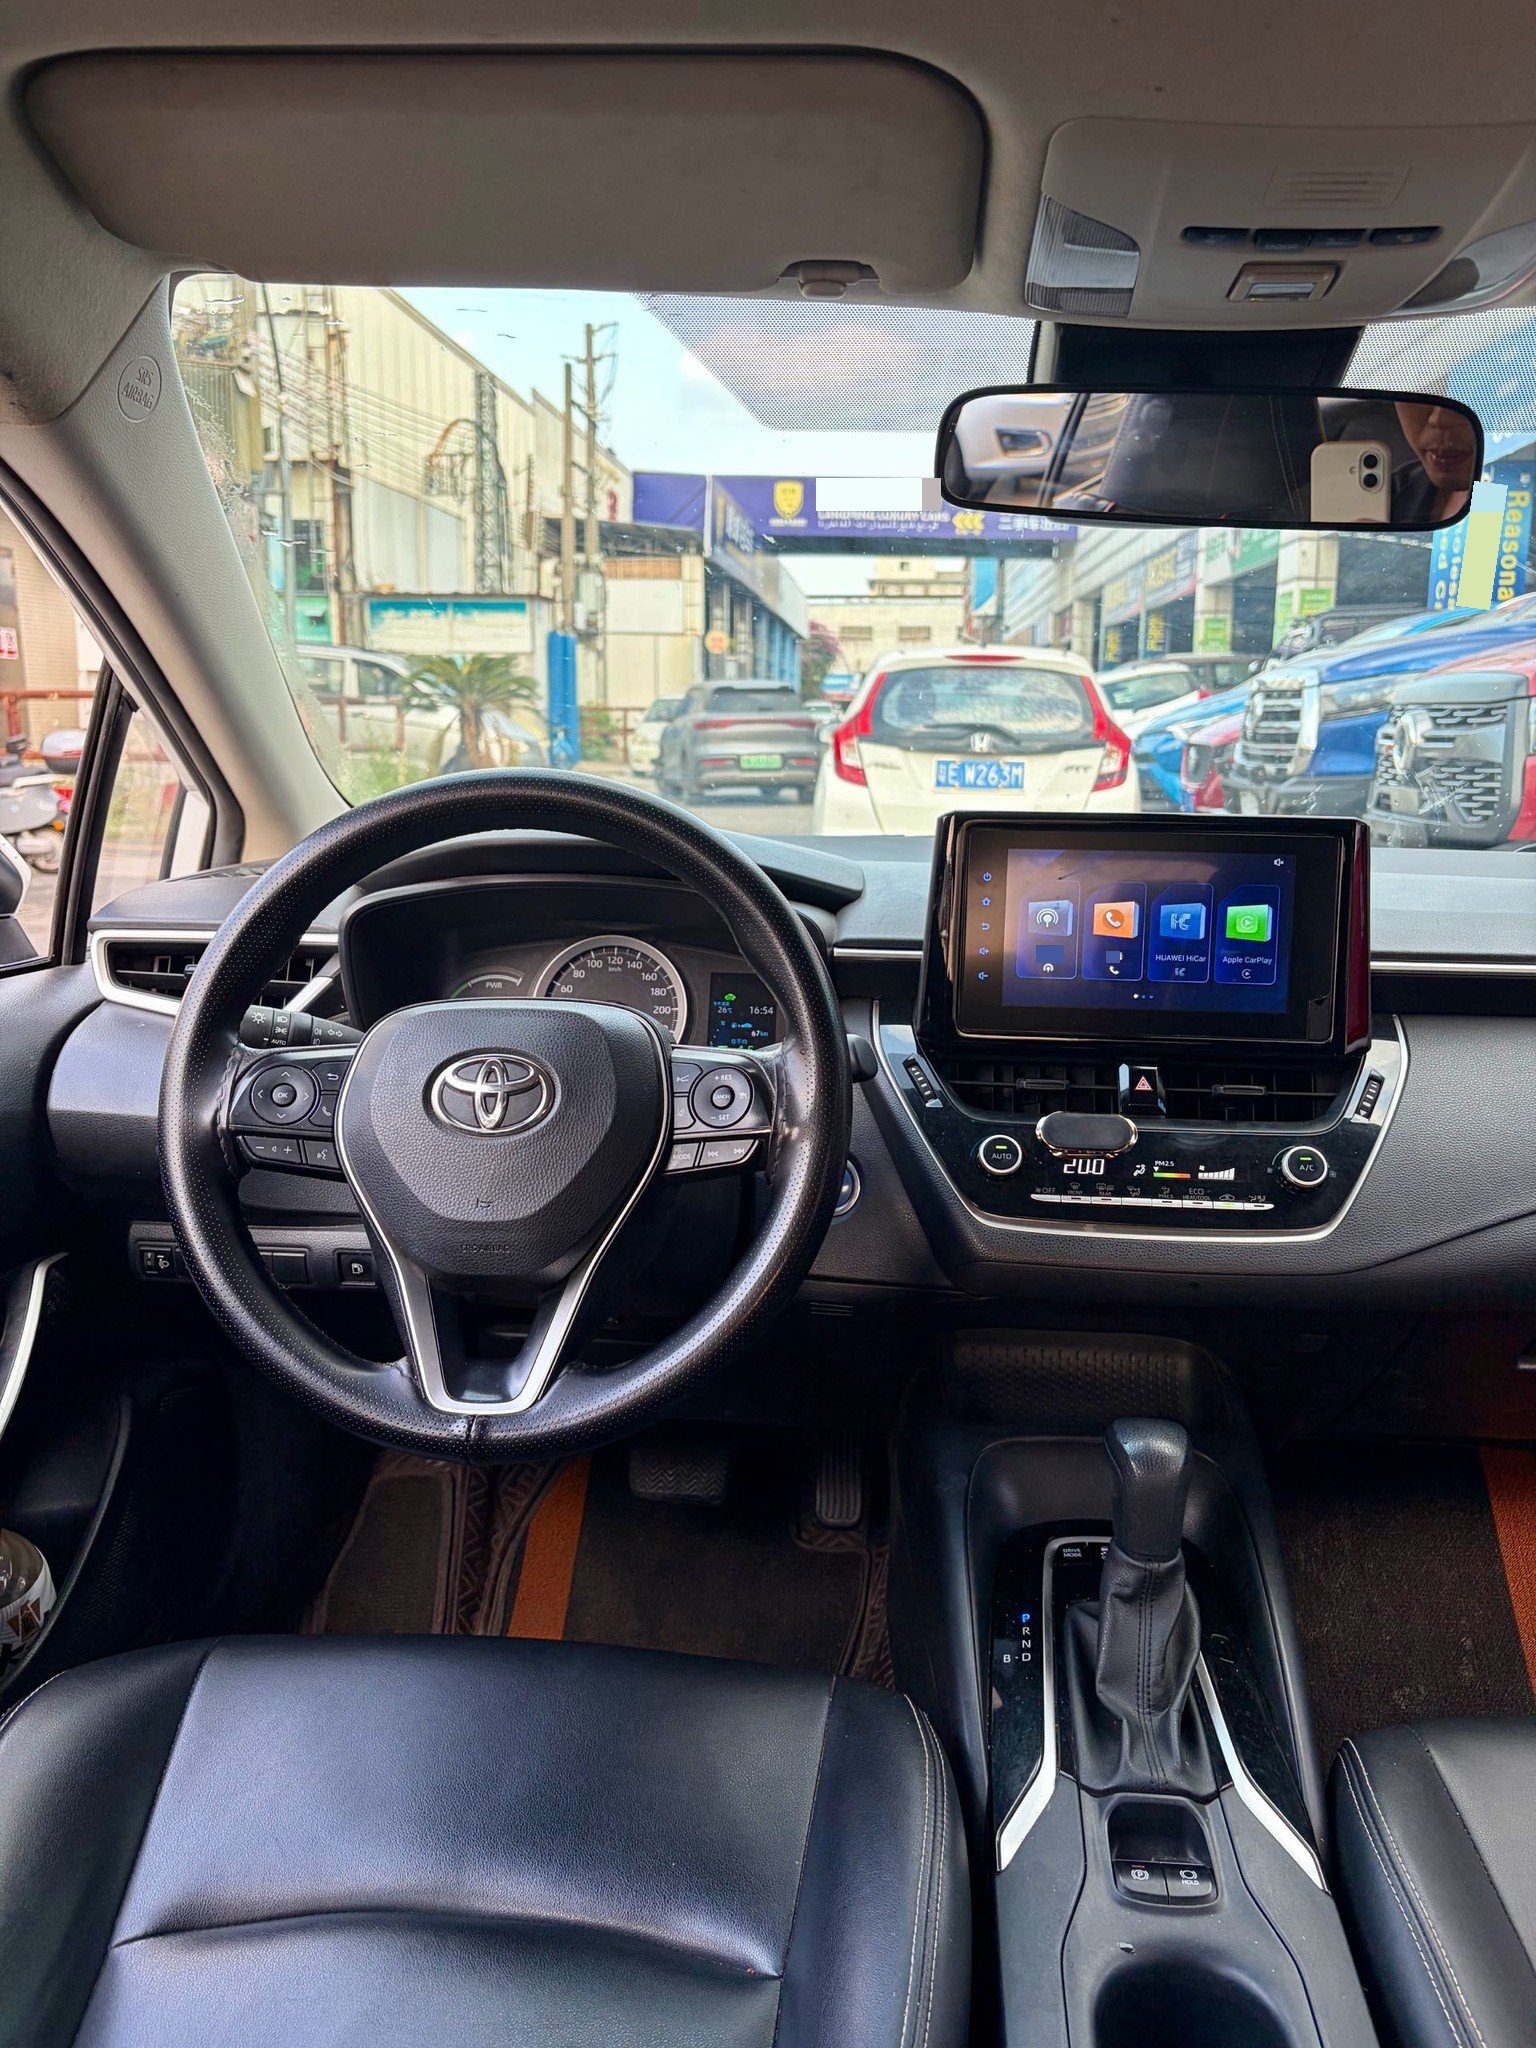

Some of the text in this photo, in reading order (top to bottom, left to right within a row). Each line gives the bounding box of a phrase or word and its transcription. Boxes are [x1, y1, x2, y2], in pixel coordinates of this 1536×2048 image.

[136, 366, 154, 388] SRS
[121, 382, 154, 411] AIRBAG
[607, 956, 623, 965] 120
[1155, 954, 1207, 963] HUAWEI HiCar
[1222, 956, 1273, 966] Apple CarPlay
[587, 959, 603, 969] 100
[626, 960, 643, 970] 140
[573, 970, 585, 979] 80
[641, 971, 658, 982] 160
[560, 985, 573, 994] 60
[650, 987, 667, 996] 180
[653, 1005, 671, 1015] 200
[749, 1006, 774, 1015] 16:54
[270, 1038, 287, 1046] AUTO
[673, 1152, 692, 1160] MODE
[1299, 1164, 1315, 1172] A/C
[1021, 1613, 1031, 1623] P
[1022, 1626, 1031, 1635] R
[1021, 1639, 1031, 1648] N
[1021, 1652, 1032, 1662] D
